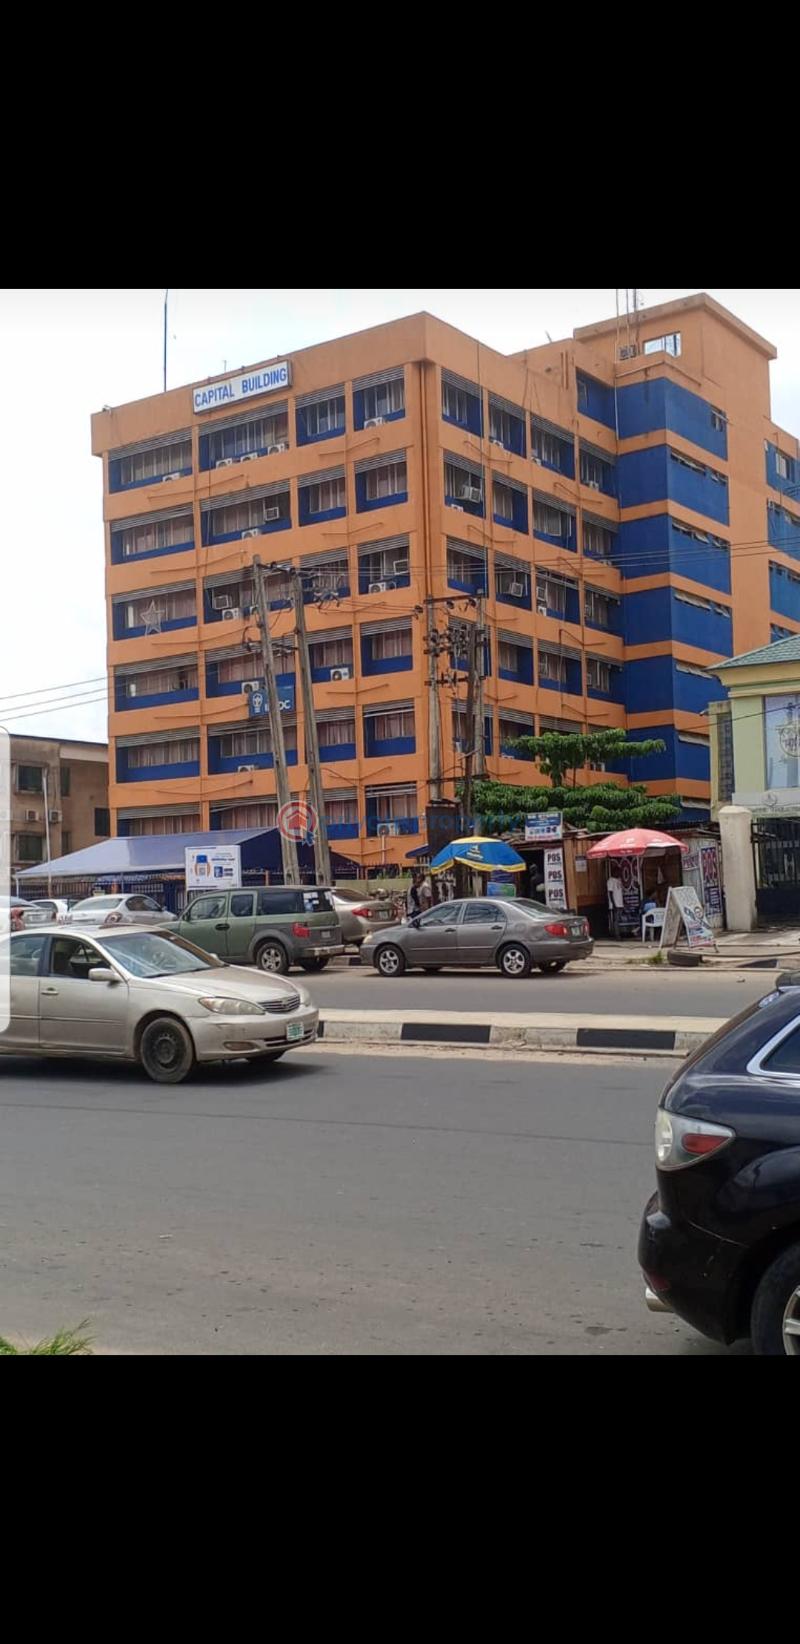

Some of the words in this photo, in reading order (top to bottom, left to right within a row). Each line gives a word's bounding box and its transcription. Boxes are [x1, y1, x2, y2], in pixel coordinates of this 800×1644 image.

[195, 383, 235, 407] CAPITAL
[241, 368, 286, 393] BUILDING
[547, 853, 561, 862] POS
[548, 870, 562, 879] POS
[549, 888, 564, 898] POS
